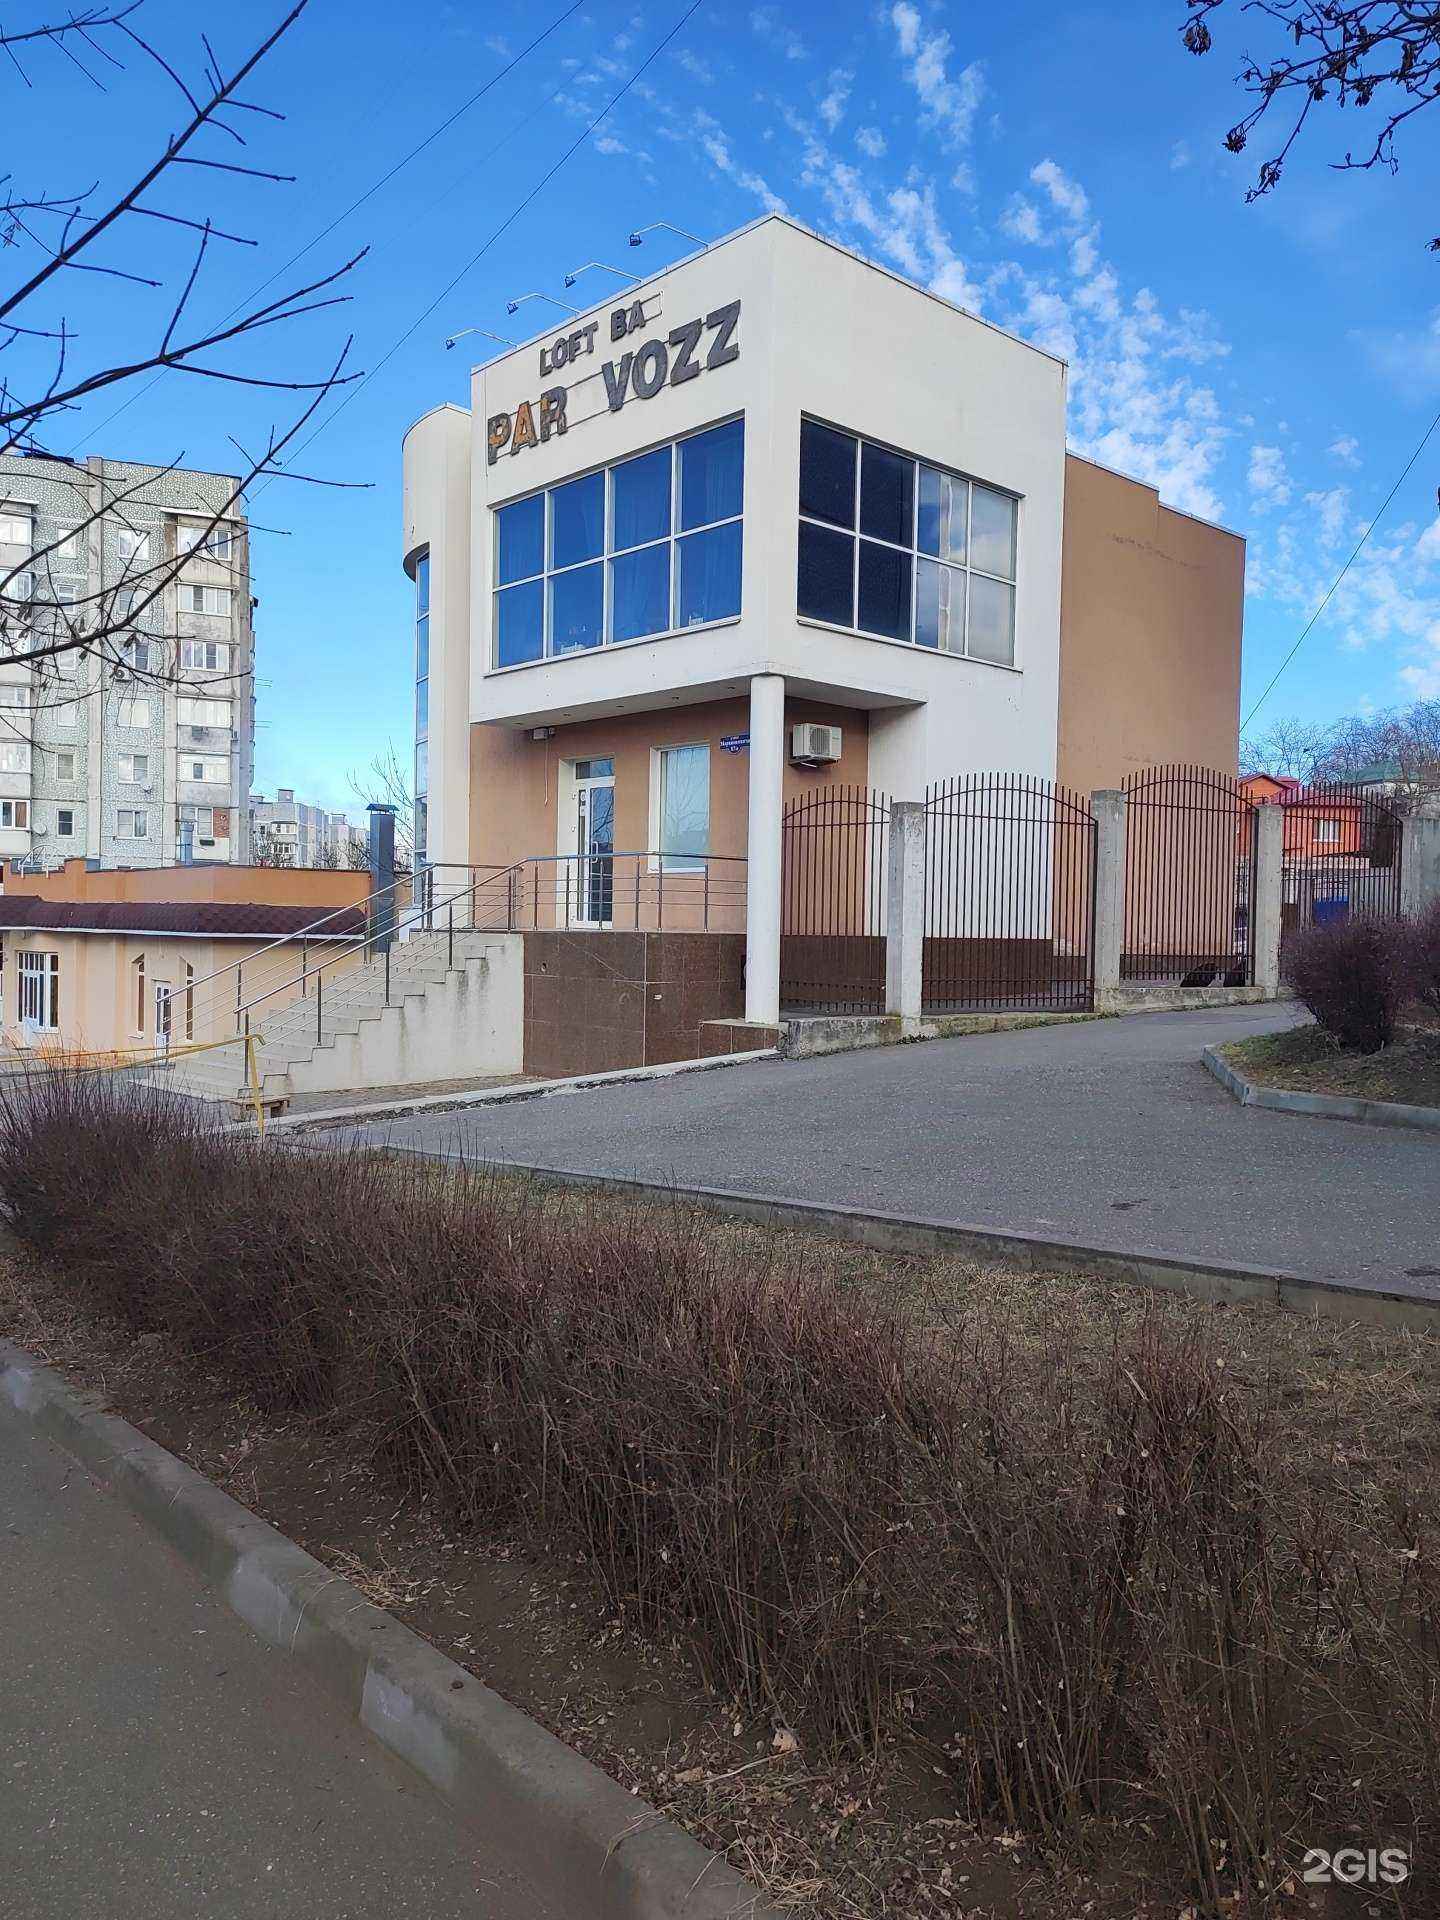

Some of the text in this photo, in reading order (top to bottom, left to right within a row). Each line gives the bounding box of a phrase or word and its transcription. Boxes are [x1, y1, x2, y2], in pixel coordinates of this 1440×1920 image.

[487, 298, 742, 465] PAR VOZZ
[540, 321, 599, 377] LOFT
